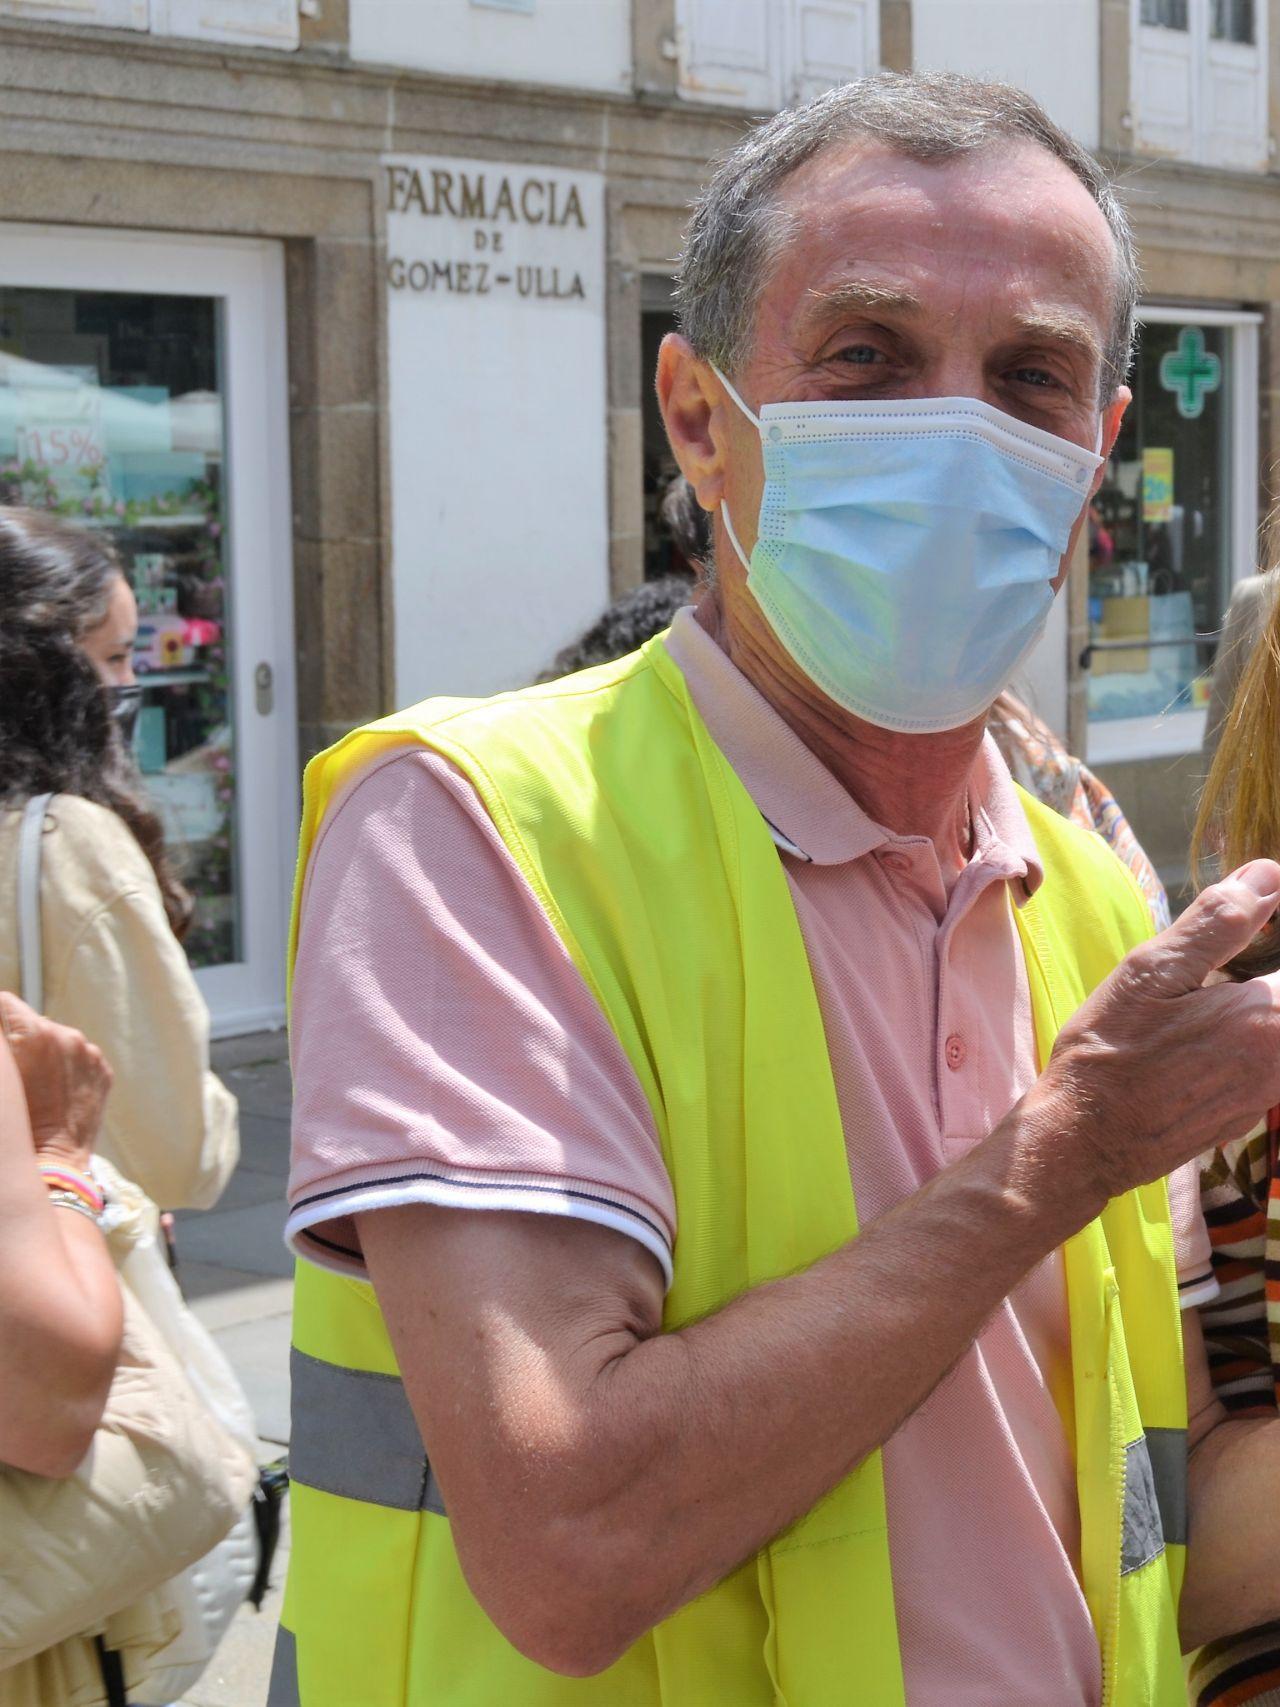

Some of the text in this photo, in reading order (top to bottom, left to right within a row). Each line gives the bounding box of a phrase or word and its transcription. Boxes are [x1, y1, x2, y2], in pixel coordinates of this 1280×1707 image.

[386, 166, 586, 228] FARMACIA
[474, 229, 504, 252] DE
[387, 257, 586, 299] GOMEZ-ULLA
